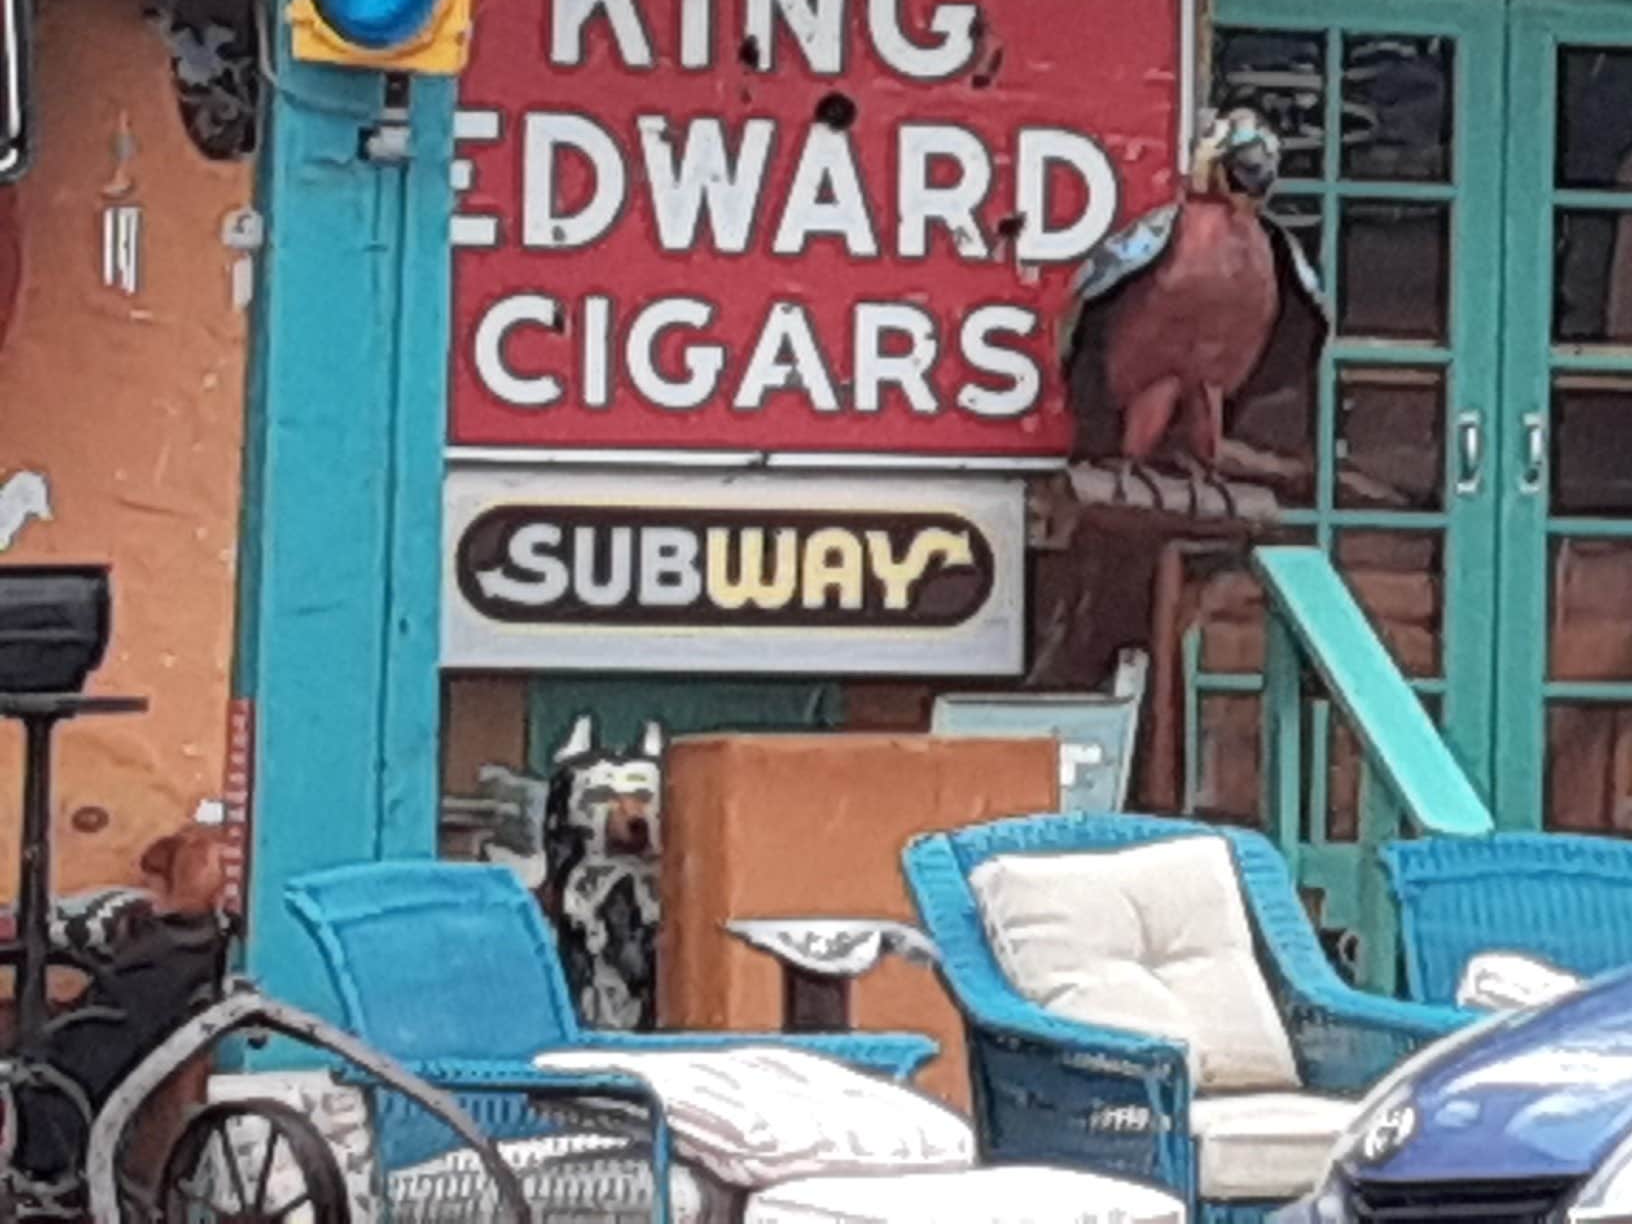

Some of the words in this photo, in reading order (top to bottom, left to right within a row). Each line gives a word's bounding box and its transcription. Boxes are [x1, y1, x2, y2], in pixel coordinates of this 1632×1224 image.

[449, 111, 1120, 263] EDWARD
[472, 294, 1042, 418] CIGARS
[475, 523, 975, 610] SUBWAY
